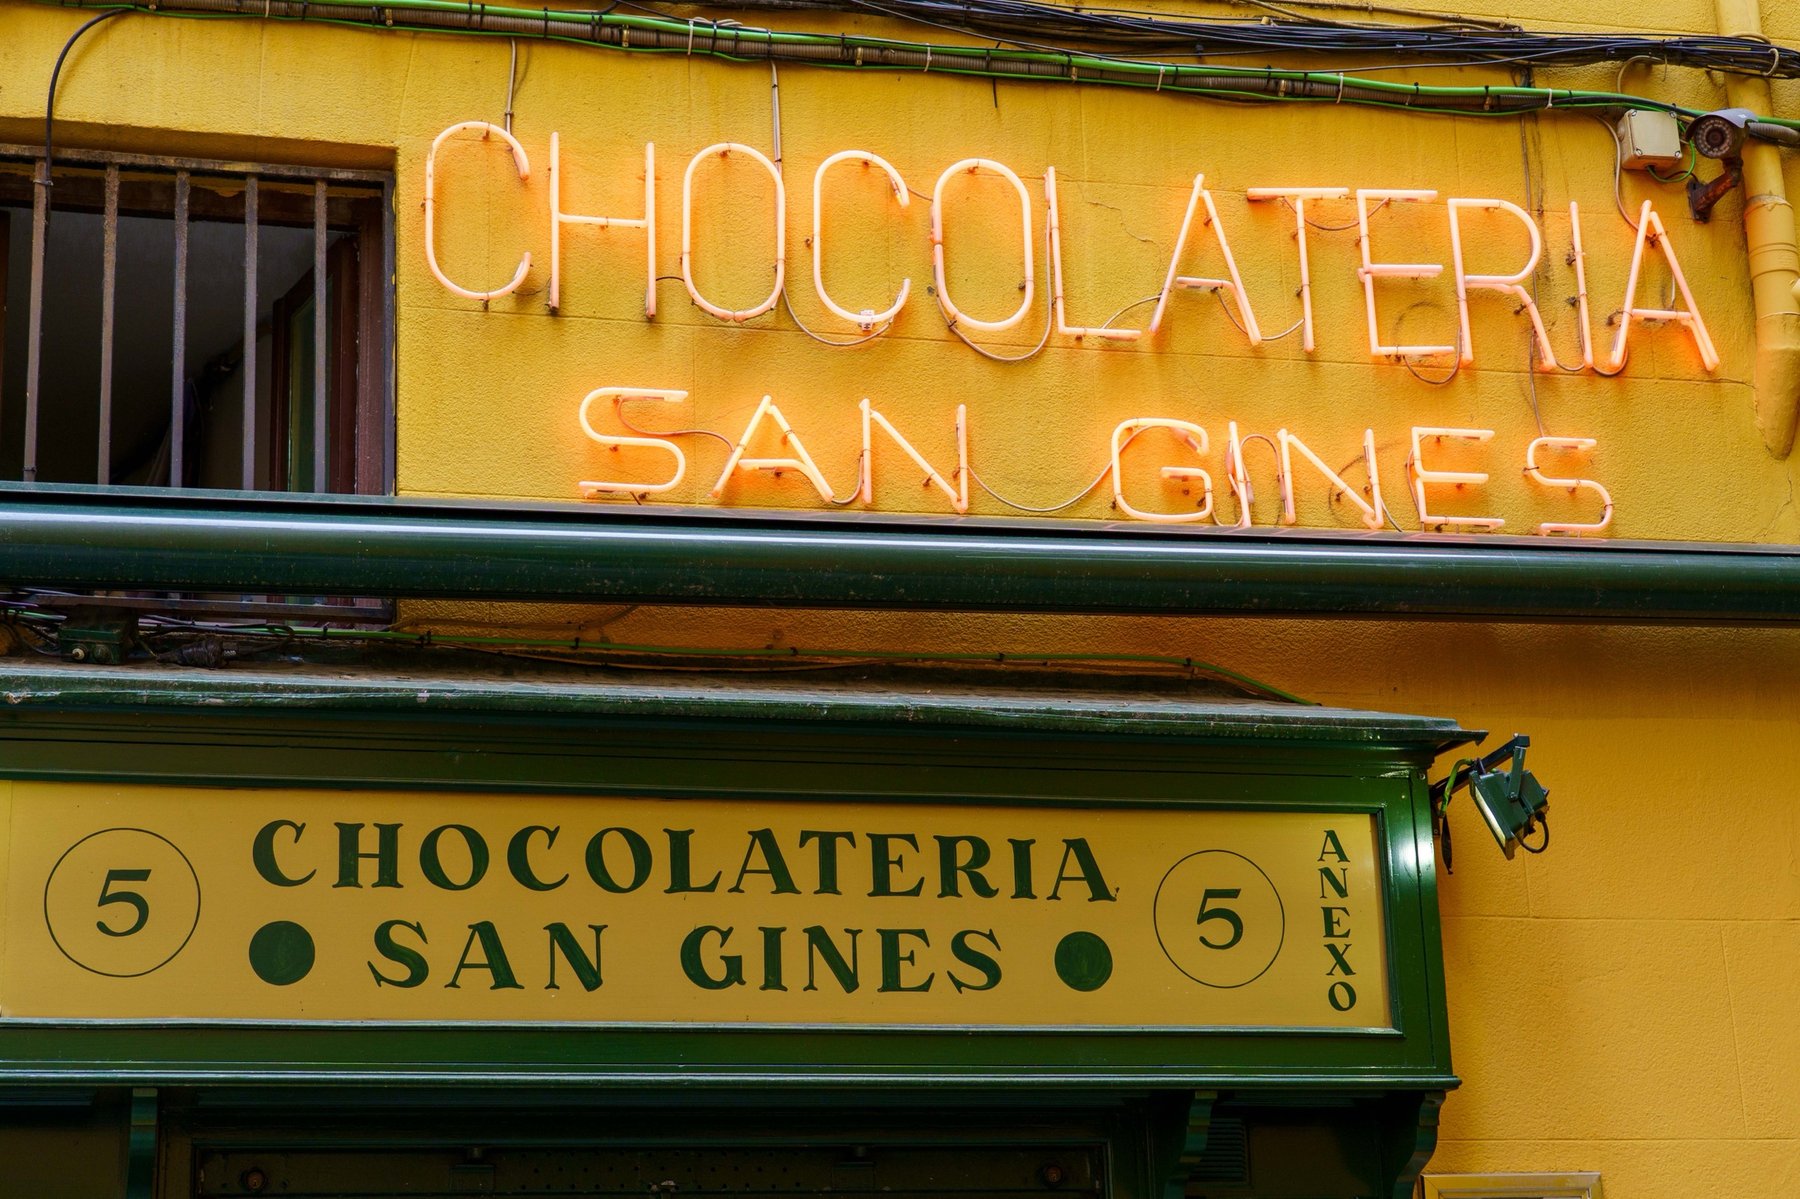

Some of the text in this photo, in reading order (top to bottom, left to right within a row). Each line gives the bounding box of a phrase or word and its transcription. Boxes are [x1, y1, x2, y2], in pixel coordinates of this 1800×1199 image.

[424, 120, 1719, 373] CHOCOLATERIA
[577, 386, 1615, 536] SAN GINES
[96, 868, 152, 937] 5
[252, 819, 1118, 903] CHOCOLATERIA
[367, 919, 1003, 995] SAN GINES
[1196, 888, 1244, 951] 5
[1317, 829, 1357, 1012] ANEXO
